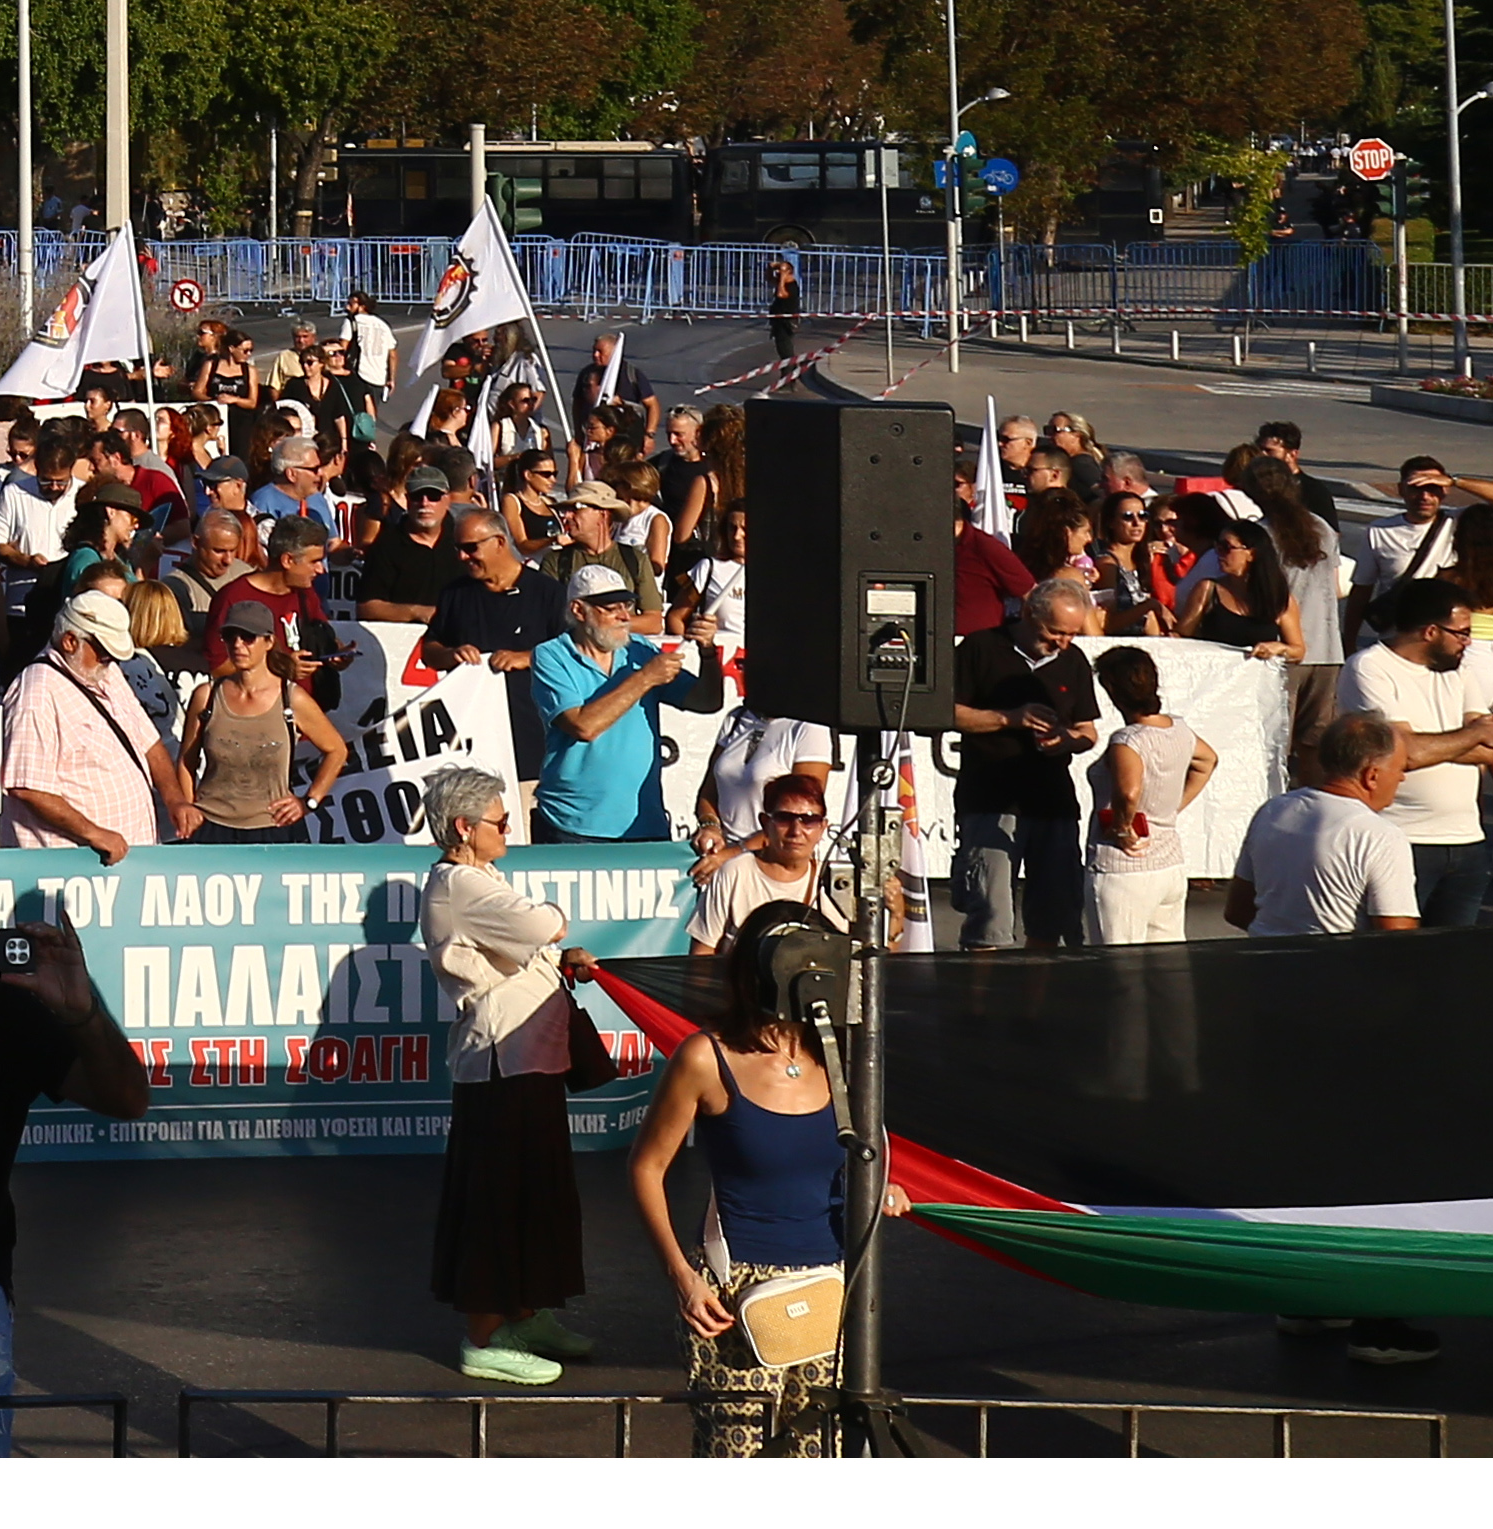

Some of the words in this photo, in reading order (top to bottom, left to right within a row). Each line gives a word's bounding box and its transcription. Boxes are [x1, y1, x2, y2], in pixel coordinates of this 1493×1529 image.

[1353, 149, 1390, 165] STOP
[37, 875, 121, 928] ΤΟΥ
[140, 873, 263, 927] ΛΑΟΥ
[281, 872, 365, 925] ΤΗΣ
[188, 1036, 269, 1087] ΣΤΗ
[284, 1034, 431, 1085] ΣΦΑΓΗ
[20, 1123, 95, 1145] ΛΟΝΙΚΗΣ
[109, 1122, 193, 1143] ΕΠΙΤΡΟΠΗ
[198, 1120, 224, 1141] ΓΙΑ
[228, 1120, 251, 1140] ΤΗ
[254, 1118, 317, 1140] ΔΙΕΘΝΗ
[322, 1116, 378, 1138] ΥΦΕΣΗ
[382, 1115, 412, 1137] ΚΑΙ
[416, 1114, 452, 1136] ΕΙΡΗ
